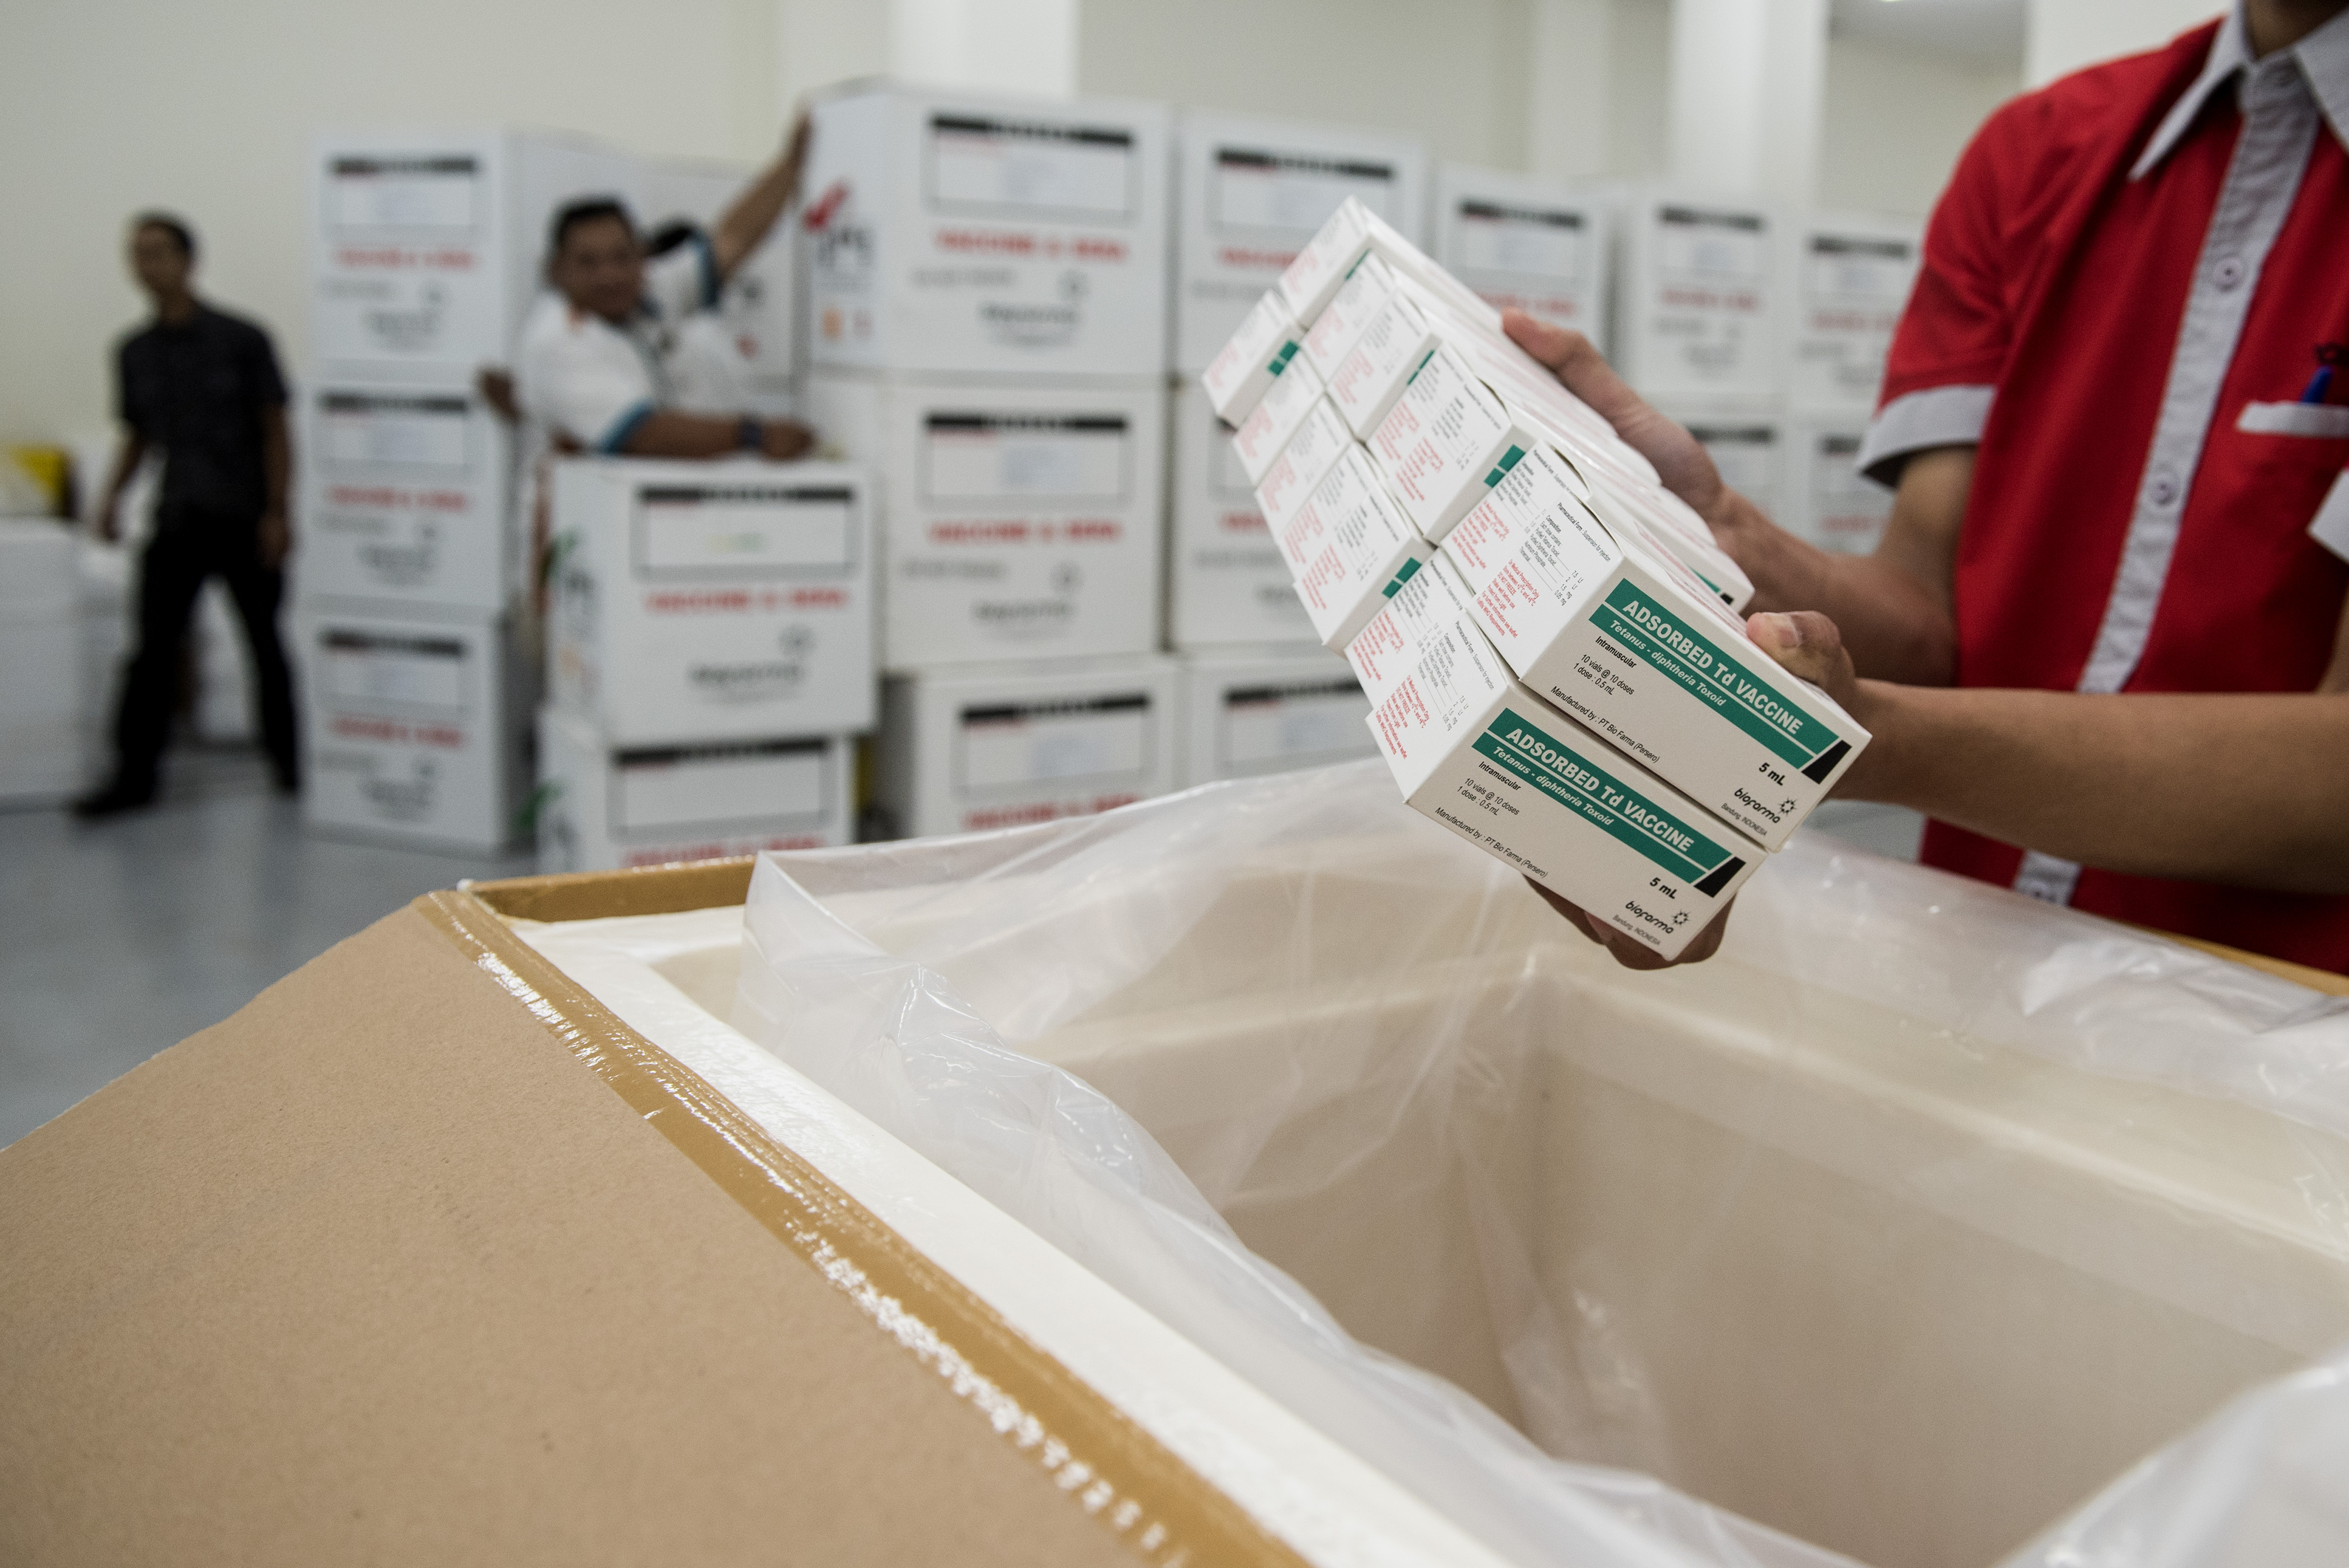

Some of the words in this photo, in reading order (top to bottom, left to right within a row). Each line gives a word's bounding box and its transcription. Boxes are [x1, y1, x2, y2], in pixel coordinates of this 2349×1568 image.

[1546, 515, 1561, 533] Composition
[1557, 502, 1577, 524] Pharmaceutical
[1582, 530, 1597, 547] Suspension
[1599, 550, 1610, 561] injection
[1536, 527, 1544, 539] Purified
[1543, 536, 1552, 548] Tetanus
[1551, 545, 1559, 557] Toxoid
[1550, 534, 1561, 546] contains
[1533, 551, 1546, 567] Phosphate
[1548, 554, 1556, 566] Toxoid
[1505, 581, 1516, 595] FREEZE
[1507, 573, 1517, 584] between
[1511, 563, 1520, 575] Medical
[1519, 572, 1533, 591] Prescription
[1498, 600, 1506, 610] Light
[1502, 591, 1510, 603] before
[1554, 590, 1562, 599] 0.05
[1489, 613, 1505, 635] Requirements
[1492, 605, 1506, 623] information
[1509, 626, 1517, 638] leaflet
[1595, 636, 1636, 668] Intramuscular
[1610, 620, 1646, 649] Tetanus
[1651, 652, 1695, 685] diphtheria
[1697, 682, 1726, 705] Toxoid
[1472, 653, 1484, 672] Suspension
[1485, 677, 1494, 688] injection
[1577, 667, 1592, 679] dose
[1594, 678, 1607, 688] 0.5
[1604, 685, 1614, 695] mL
[1581, 654, 1590, 662] 10
[1589, 660, 1602, 672] vials
[1601, 669, 1610, 678] @
[1610, 674, 1618, 682] 10
[1617, 681, 1634, 694] doses
[1622, 600, 1712, 668] ADSORBED
[1714, 662, 1736, 686] Td
[1736, 678, 1803, 734] VACCINE
[1402, 698, 1410, 714] FREEZE
[1550, 686, 1590, 715] Manufactured
[1587, 711, 1596, 720] by
[1598, 718, 1610, 727] PT
[1606, 724, 1617, 733] Bio
[1616, 731, 1635, 746] Farma
[1633, 743, 1660, 763] (Persero)
[1479, 761, 1520, 790] Intramuscular
[1493, 746, 1530, 773] Tetanus
[1536, 776, 1582, 806] diphtheria
[1583, 803, 1614, 825] Toxoid
[1759, 762, 1769, 772] 5
[1767, 770, 1785, 785] mL
[1461, 789, 1476, 800] dose
[1479, 799, 1491, 809] 0.5
[1489, 806, 1499, 815] mL
[1472, 783, 1486, 795] vials
[1485, 792, 1495, 800] @
[1501, 802, 1519, 815] doses
[1505, 728, 1599, 790] ADSORBED
[1601, 785, 1624, 806] Td
[1624, 800, 1694, 851] VACCINE
[1734, 788, 1780, 823] biofarma
[1741, 816, 1766, 836] INDONESIA
[1435, 807, 1475, 833] Manufactured
[1473, 830, 1482, 839] by
[1484, 836, 1496, 844] PT
[1493, 842, 1503, 851] Bio
[1503, 847, 1522, 862] Farma
[1520, 860, 1547, 877] (Persero)
[1650, 877, 1660, 886] 5
[1659, 885, 1677, 899] mL
[1625, 901, 1673, 933] biofarma
